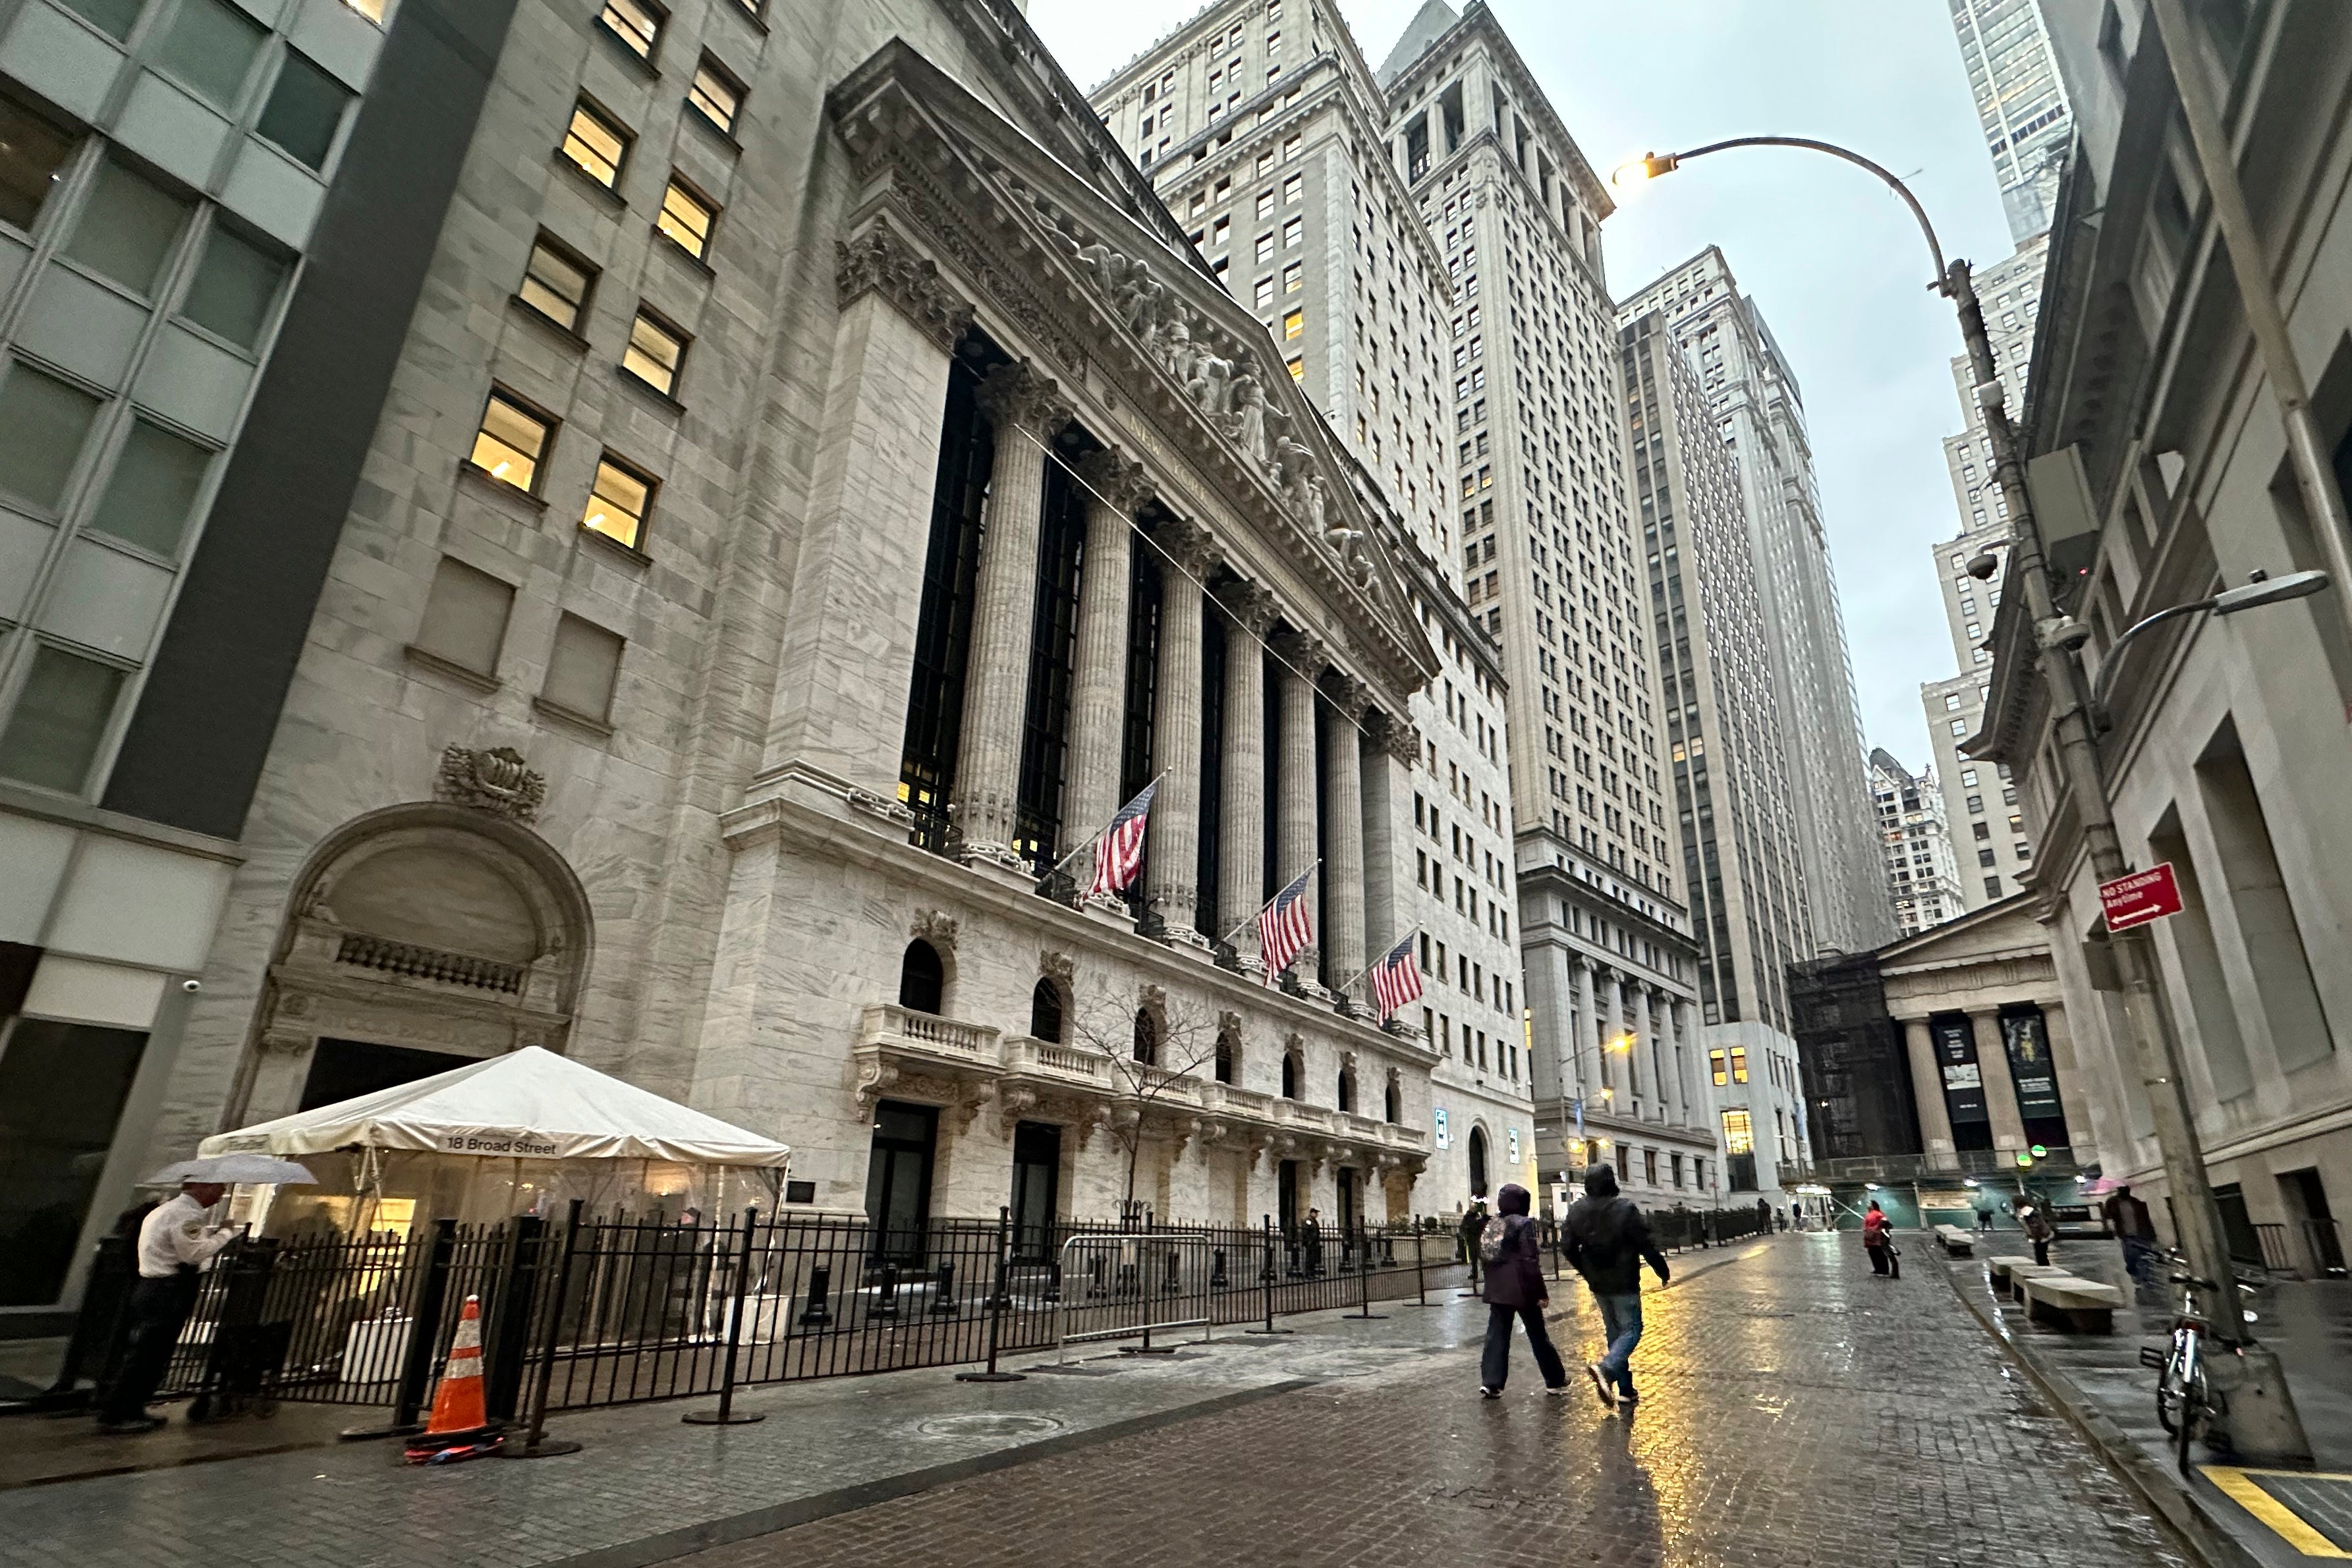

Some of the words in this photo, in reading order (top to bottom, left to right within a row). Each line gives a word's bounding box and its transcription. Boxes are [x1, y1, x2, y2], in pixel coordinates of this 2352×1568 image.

[2102, 886, 2117, 898] NO
[2116, 871, 2162, 894] STANDING
[447, 1136, 464, 1149] 18
[466, 1138, 511, 1152] Broad
[515, 1142, 557, 1154] Street
